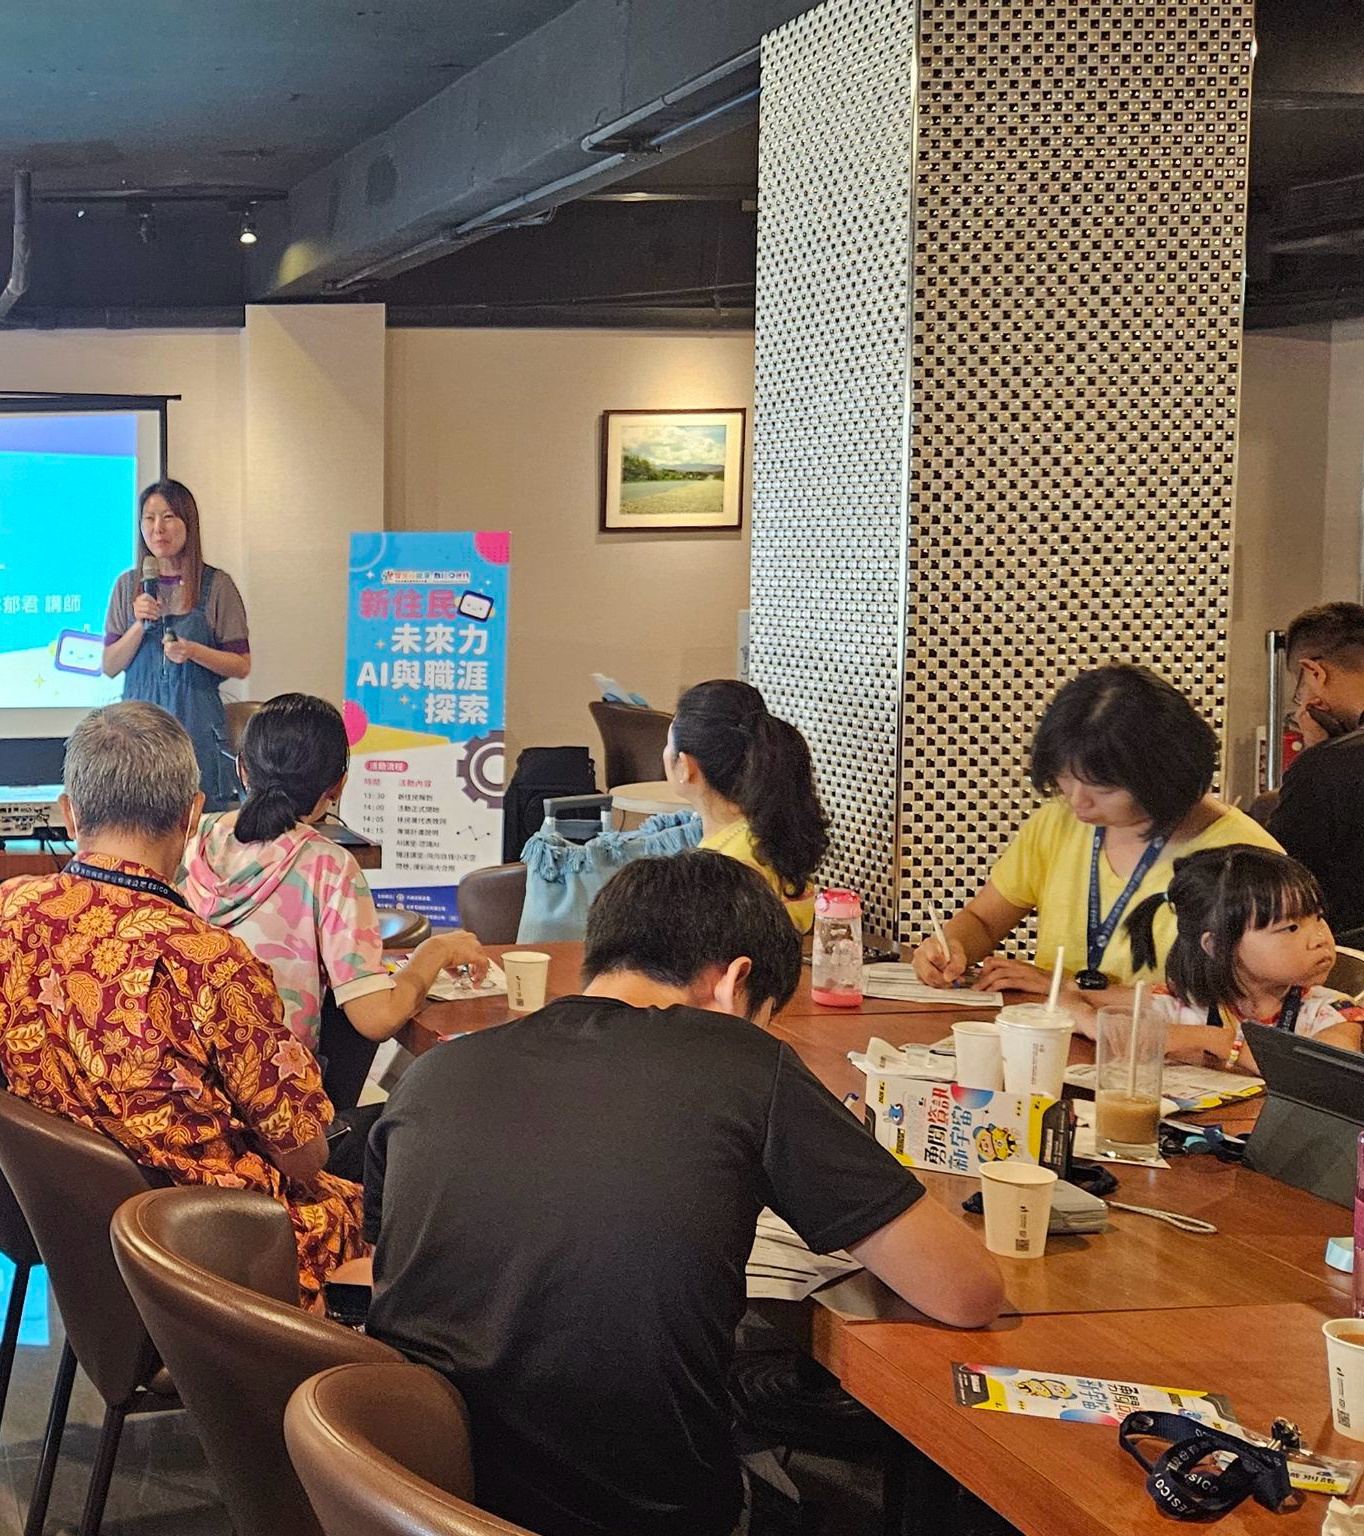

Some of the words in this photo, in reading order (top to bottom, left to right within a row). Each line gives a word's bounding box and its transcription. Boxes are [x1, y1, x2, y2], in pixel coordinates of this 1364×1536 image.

[44, 594, 81, 613] 講師
[359, 588, 457, 620] 新住民
[390, 623, 488, 655] 未來力
[356, 660, 489, 691] AI與職涯
[424, 693, 489, 726] 探索
[948, 1104, 972, 1172] 新宇宙
